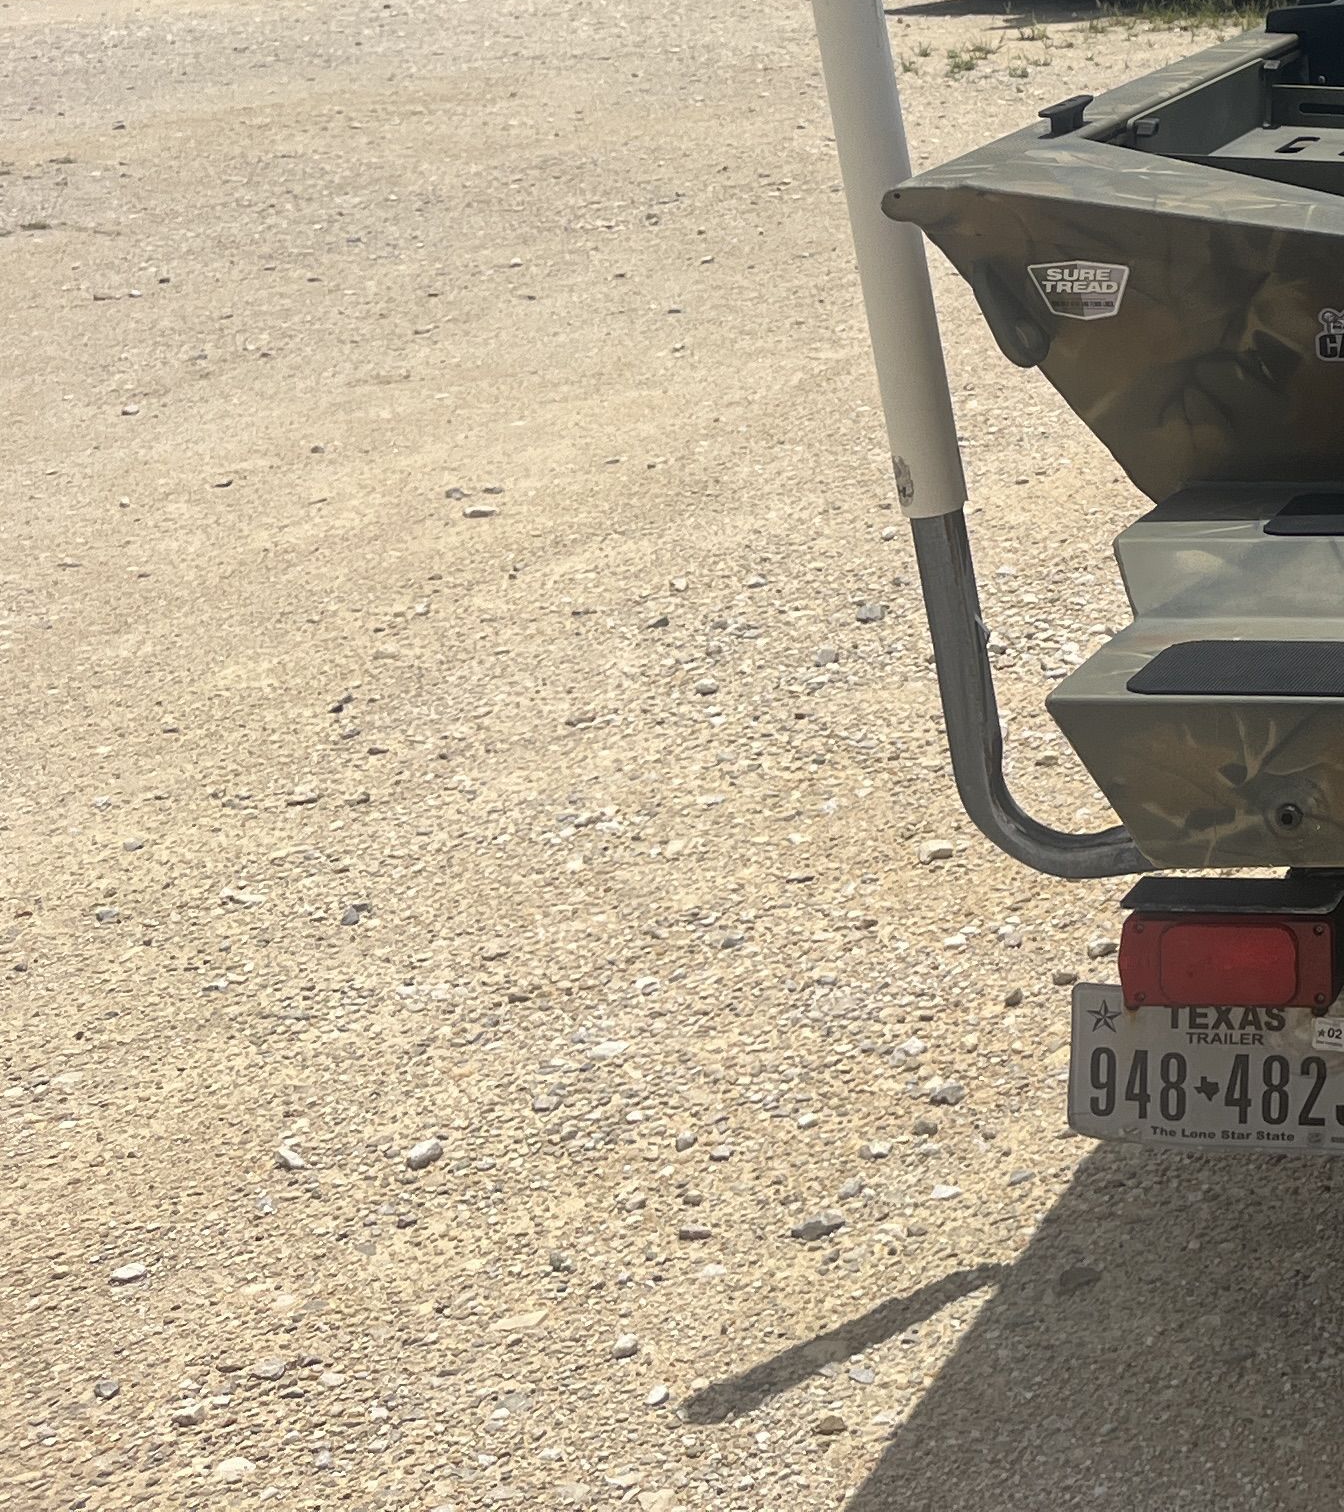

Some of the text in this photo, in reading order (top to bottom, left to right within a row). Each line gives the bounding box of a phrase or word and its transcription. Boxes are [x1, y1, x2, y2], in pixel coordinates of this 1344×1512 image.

[1046, 268, 1111, 281] SURE
[1042, 281, 1118, 293] TREAD
[1168, 1006, 1286, 1031] TEXAS
[1186, 1032, 1264, 1046] TRAILER
[1327, 1028, 1343, 1039] 02
[1089, 1046, 1188, 1122] 948
[1151, 1125, 1295, 1143] The Lone Star State
